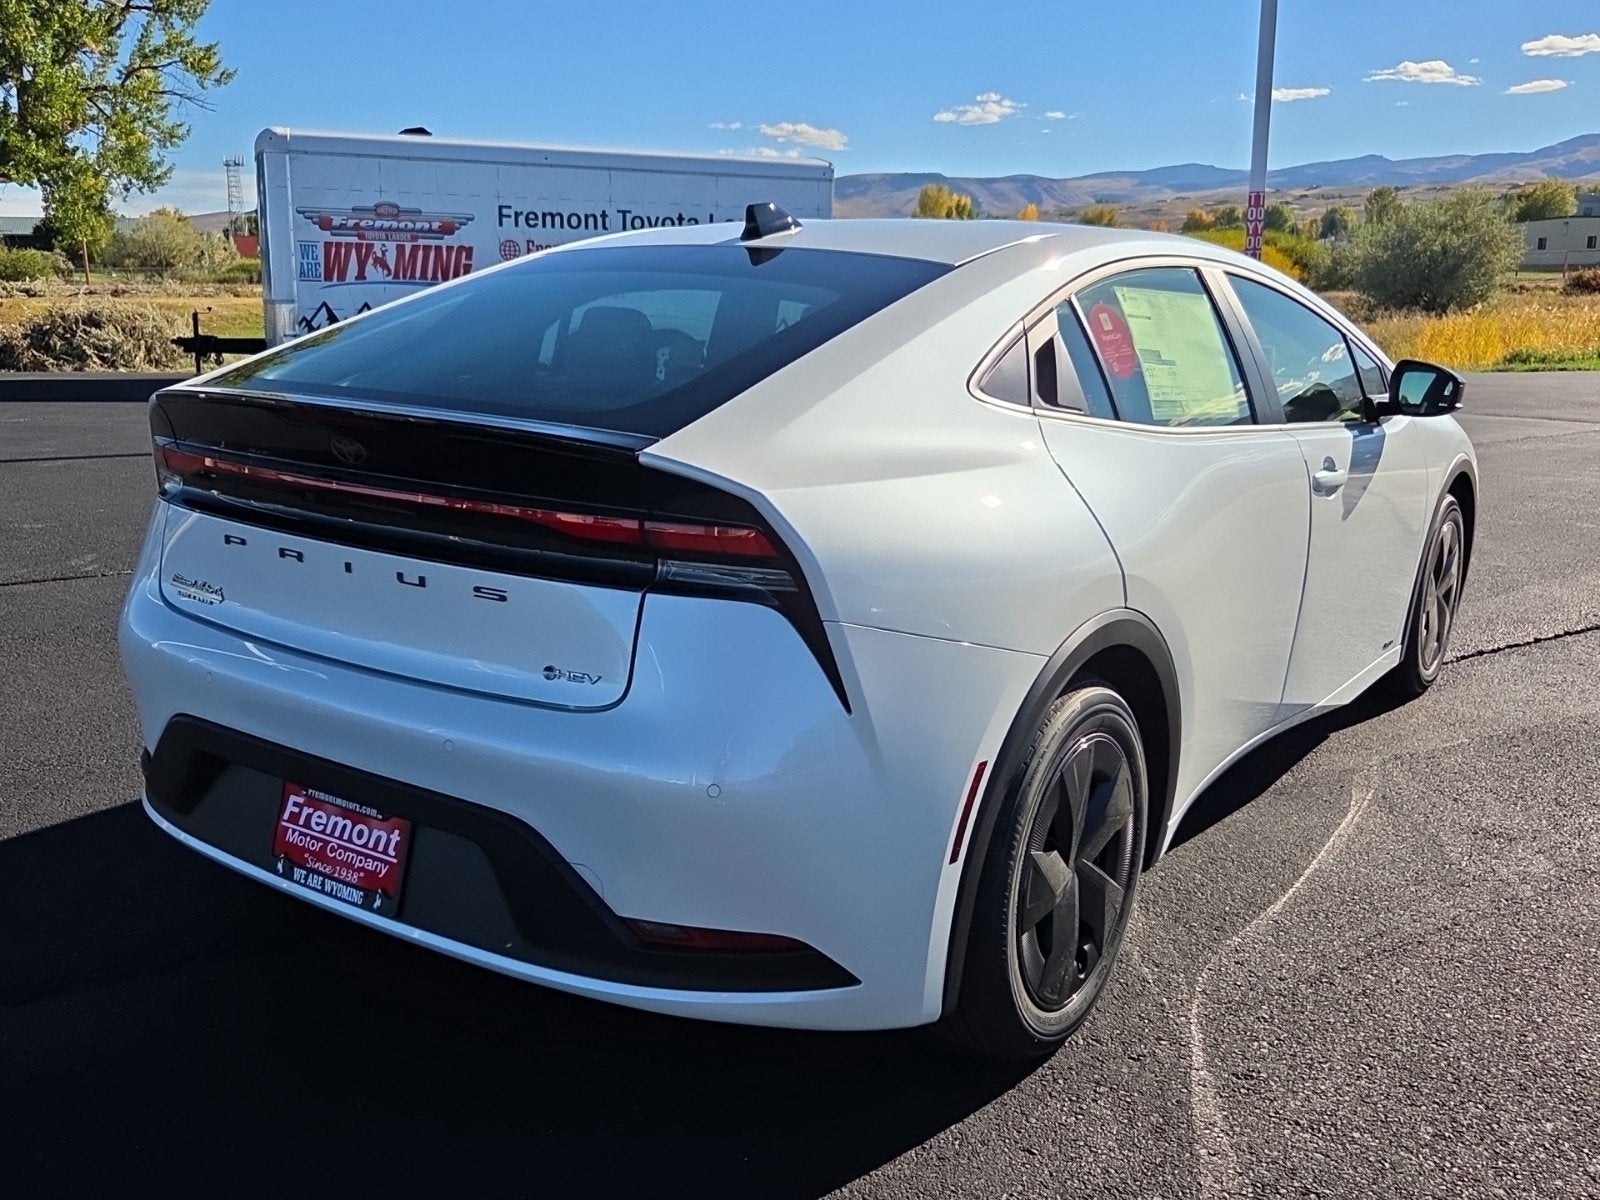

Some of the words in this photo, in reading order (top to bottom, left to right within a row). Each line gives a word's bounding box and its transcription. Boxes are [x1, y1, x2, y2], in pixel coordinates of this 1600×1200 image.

[329, 215, 443, 232] Fremont
[497, 204, 609, 231] Fremont
[365, 232, 387, 241] TOYOTA
[299, 243, 319, 261] WE
[299, 261, 322, 279] ARE
[223, 533, 509, 603] PRIUS
[281, 794, 402, 857] Fremont
[284, 828, 323, 852] Motor
[326, 842, 390, 877] Company
[293, 867, 306, 884] WE
[306, 874, 324, 890] ARE
[323, 878, 364, 905] WYOMING
